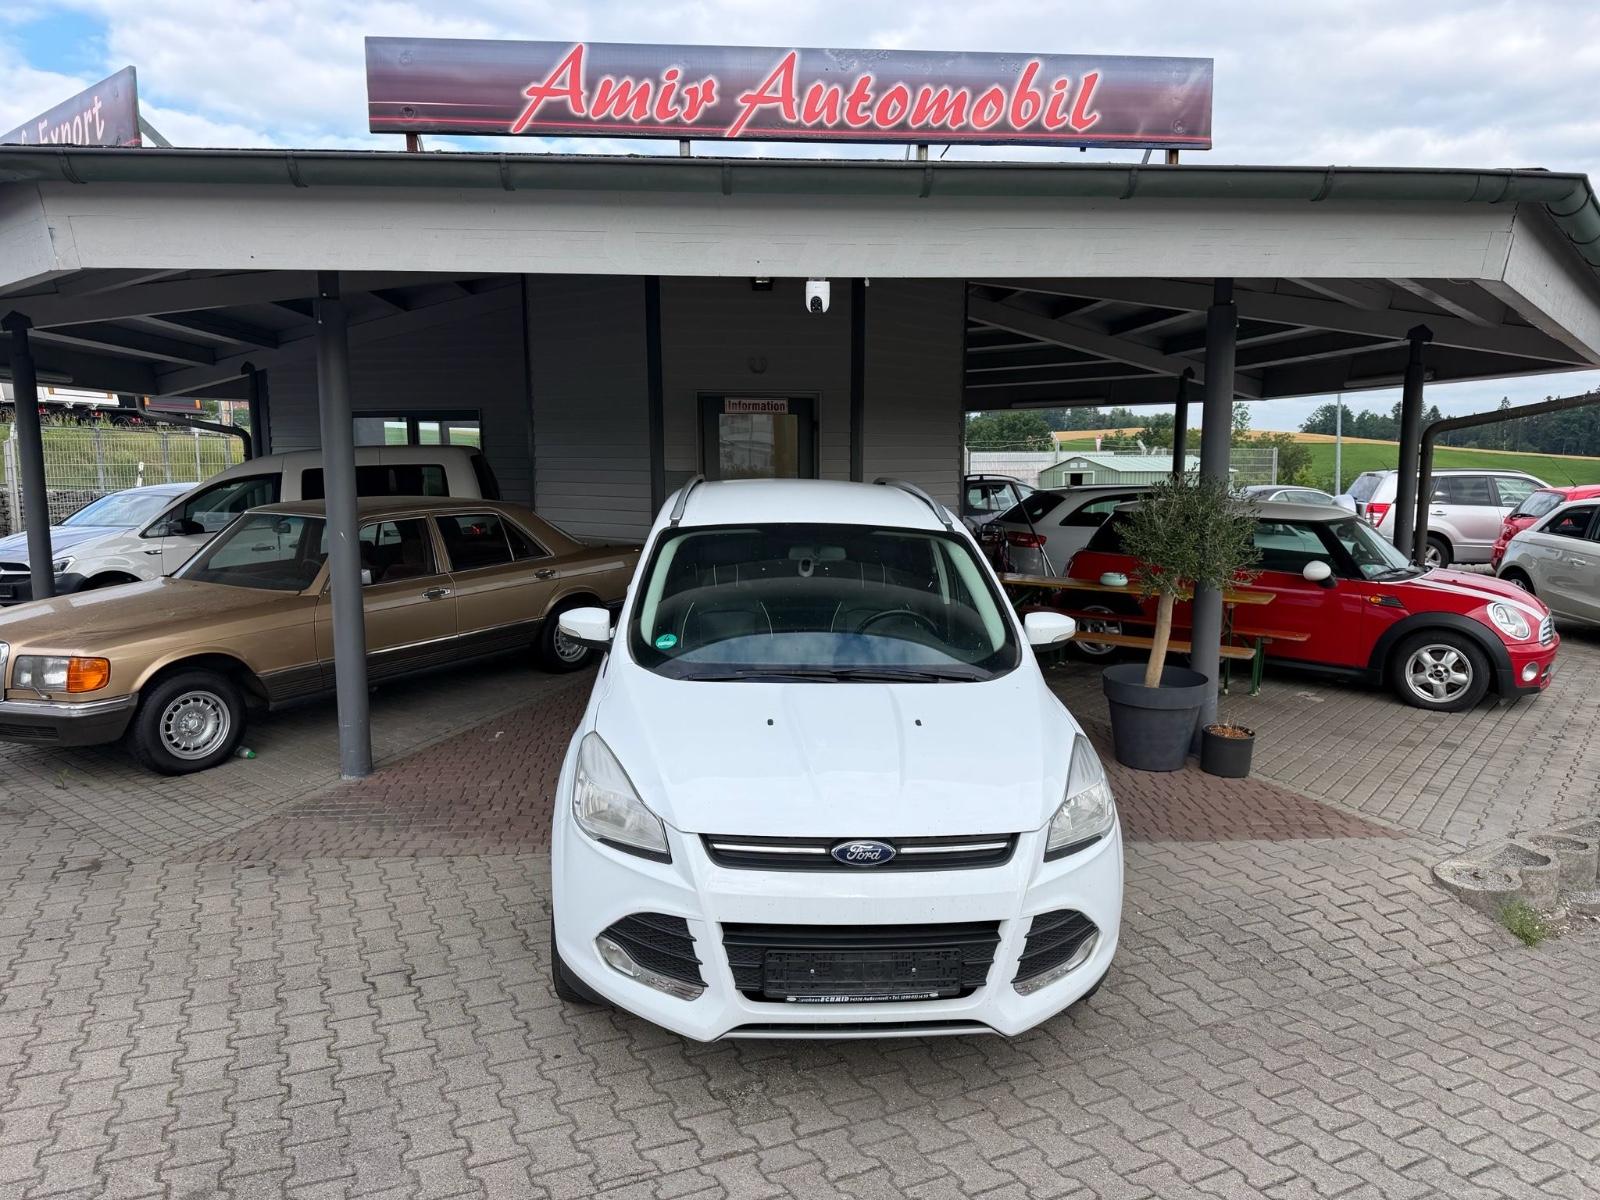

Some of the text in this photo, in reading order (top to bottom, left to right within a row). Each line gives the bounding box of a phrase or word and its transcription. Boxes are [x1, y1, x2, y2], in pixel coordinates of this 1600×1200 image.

[511, 43, 1099, 138] Amir Automobil
[727, 400, 786, 412] Information
[846, 844, 882, 861] Ford
